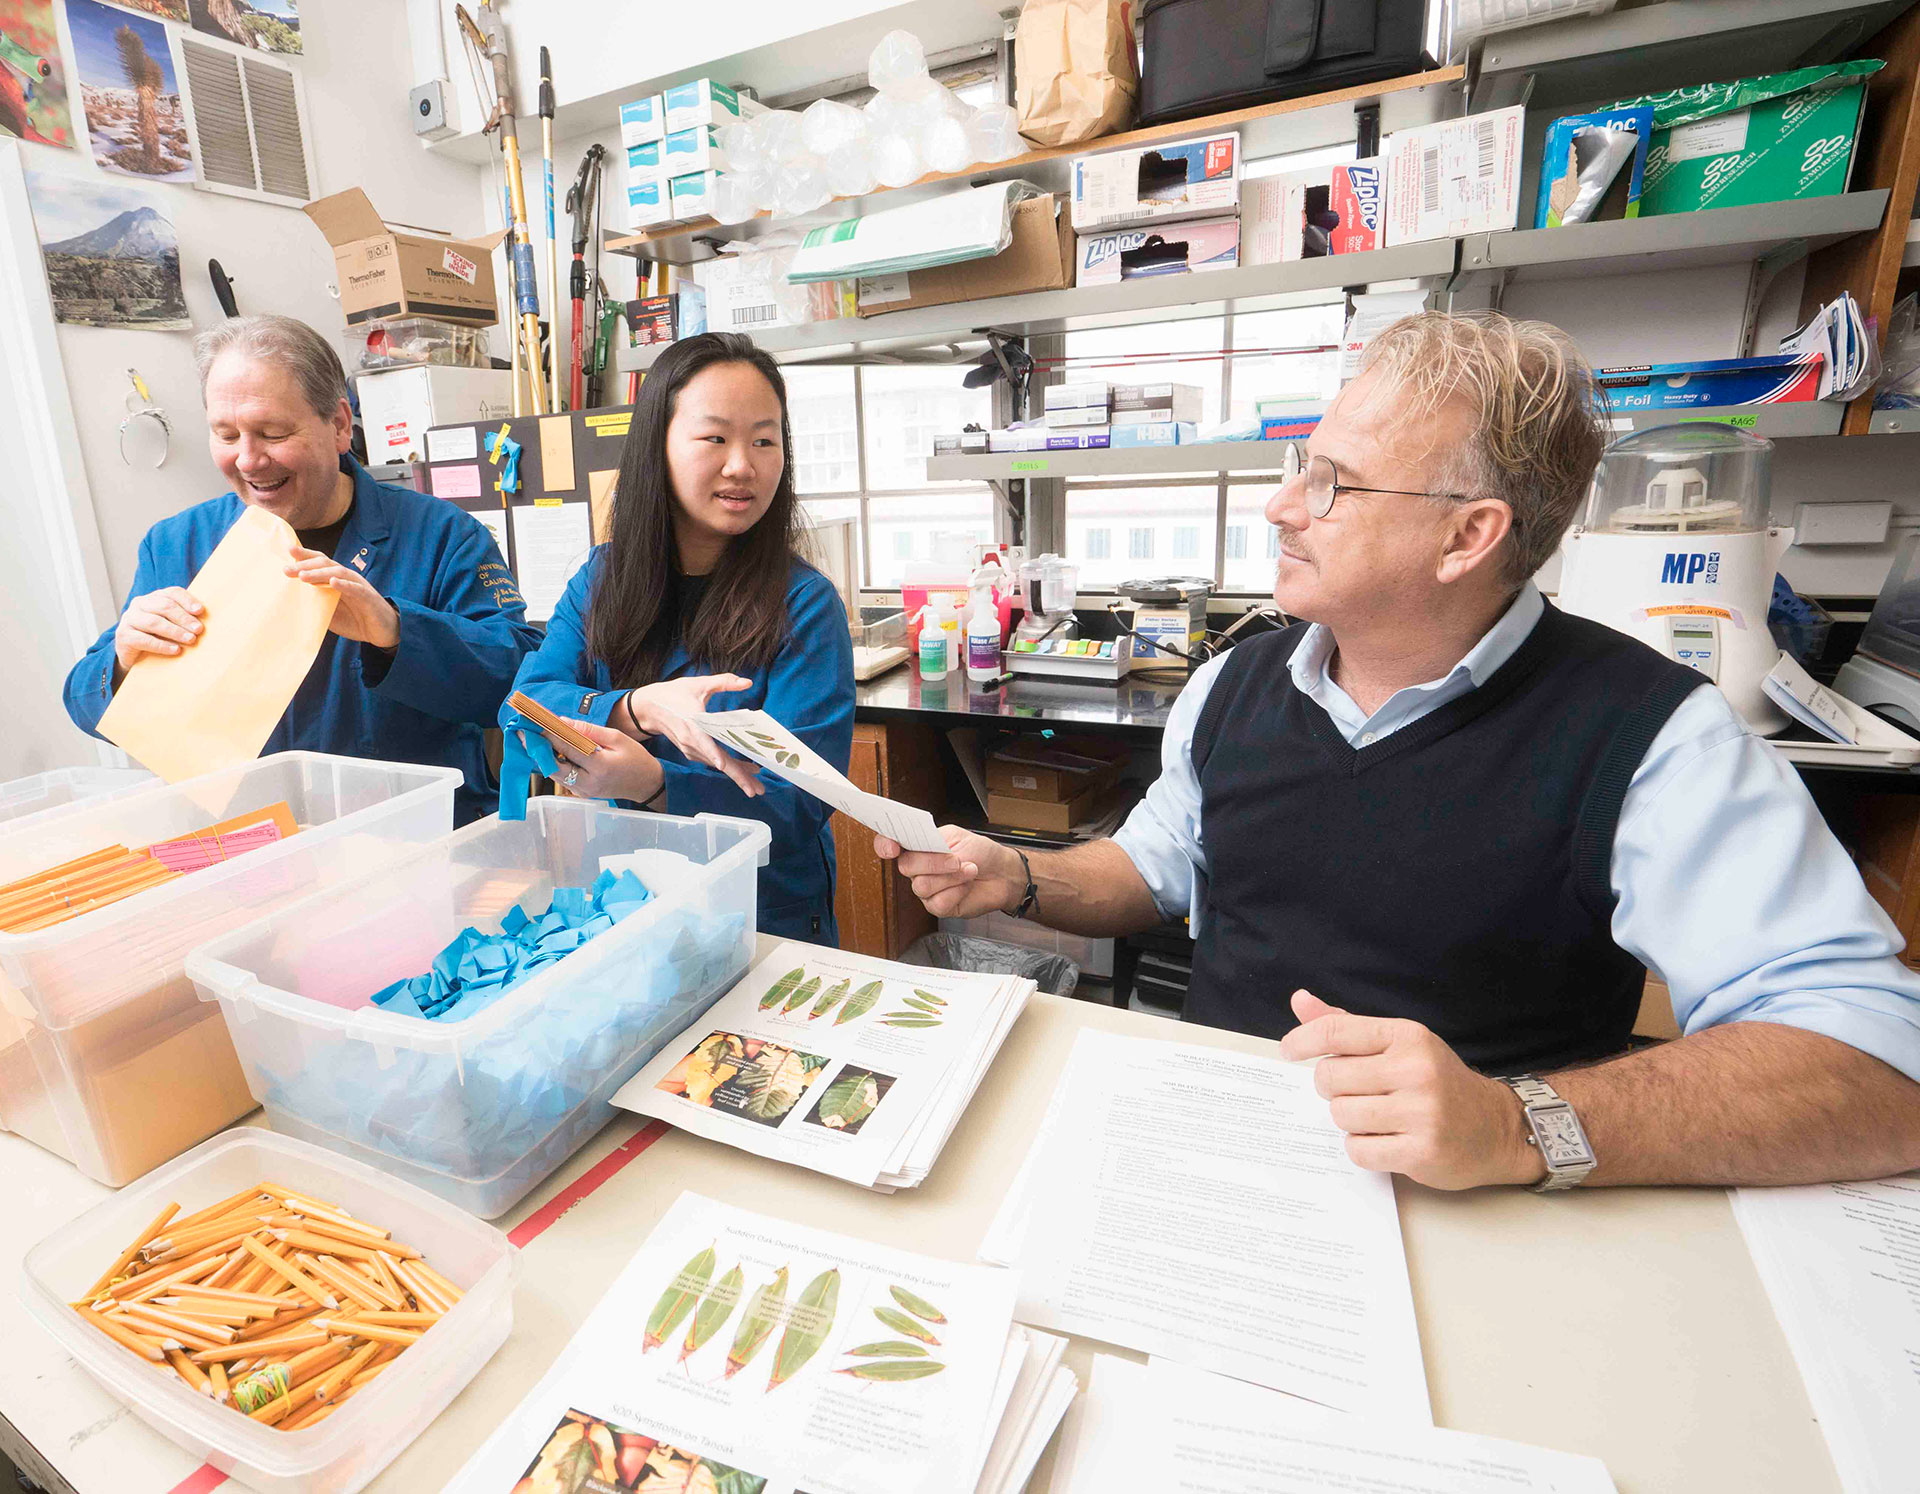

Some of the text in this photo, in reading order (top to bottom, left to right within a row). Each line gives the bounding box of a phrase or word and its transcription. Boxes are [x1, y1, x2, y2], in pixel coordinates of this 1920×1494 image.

[1798, 165, 1822, 185] ZYMO
[1349, 166, 1380, 230] Ziploc
[446, 249, 474, 270] PACKING
[452, 259, 467, 270] SLIP
[348, 269, 386, 284] ThermoFisher
[448, 263, 469, 279] INSIDE
[1346, 342, 1363, 352] 3M
[1603, 365, 1651, 373] KIRKLAND
[1602, 375, 1649, 385] KIRKLAND
[1625, 394, 1652, 406] Foil
[1730, 415, 1755, 426] BAGS
[479, 571, 489, 580] OF
[1661, 553, 1706, 584] MP
[725, 1226, 951, 1289] Sudden Oak Death Symptoms on California Bay Laurel
[610, 1403, 735, 1456] SOD Symptoms on Tanoak
